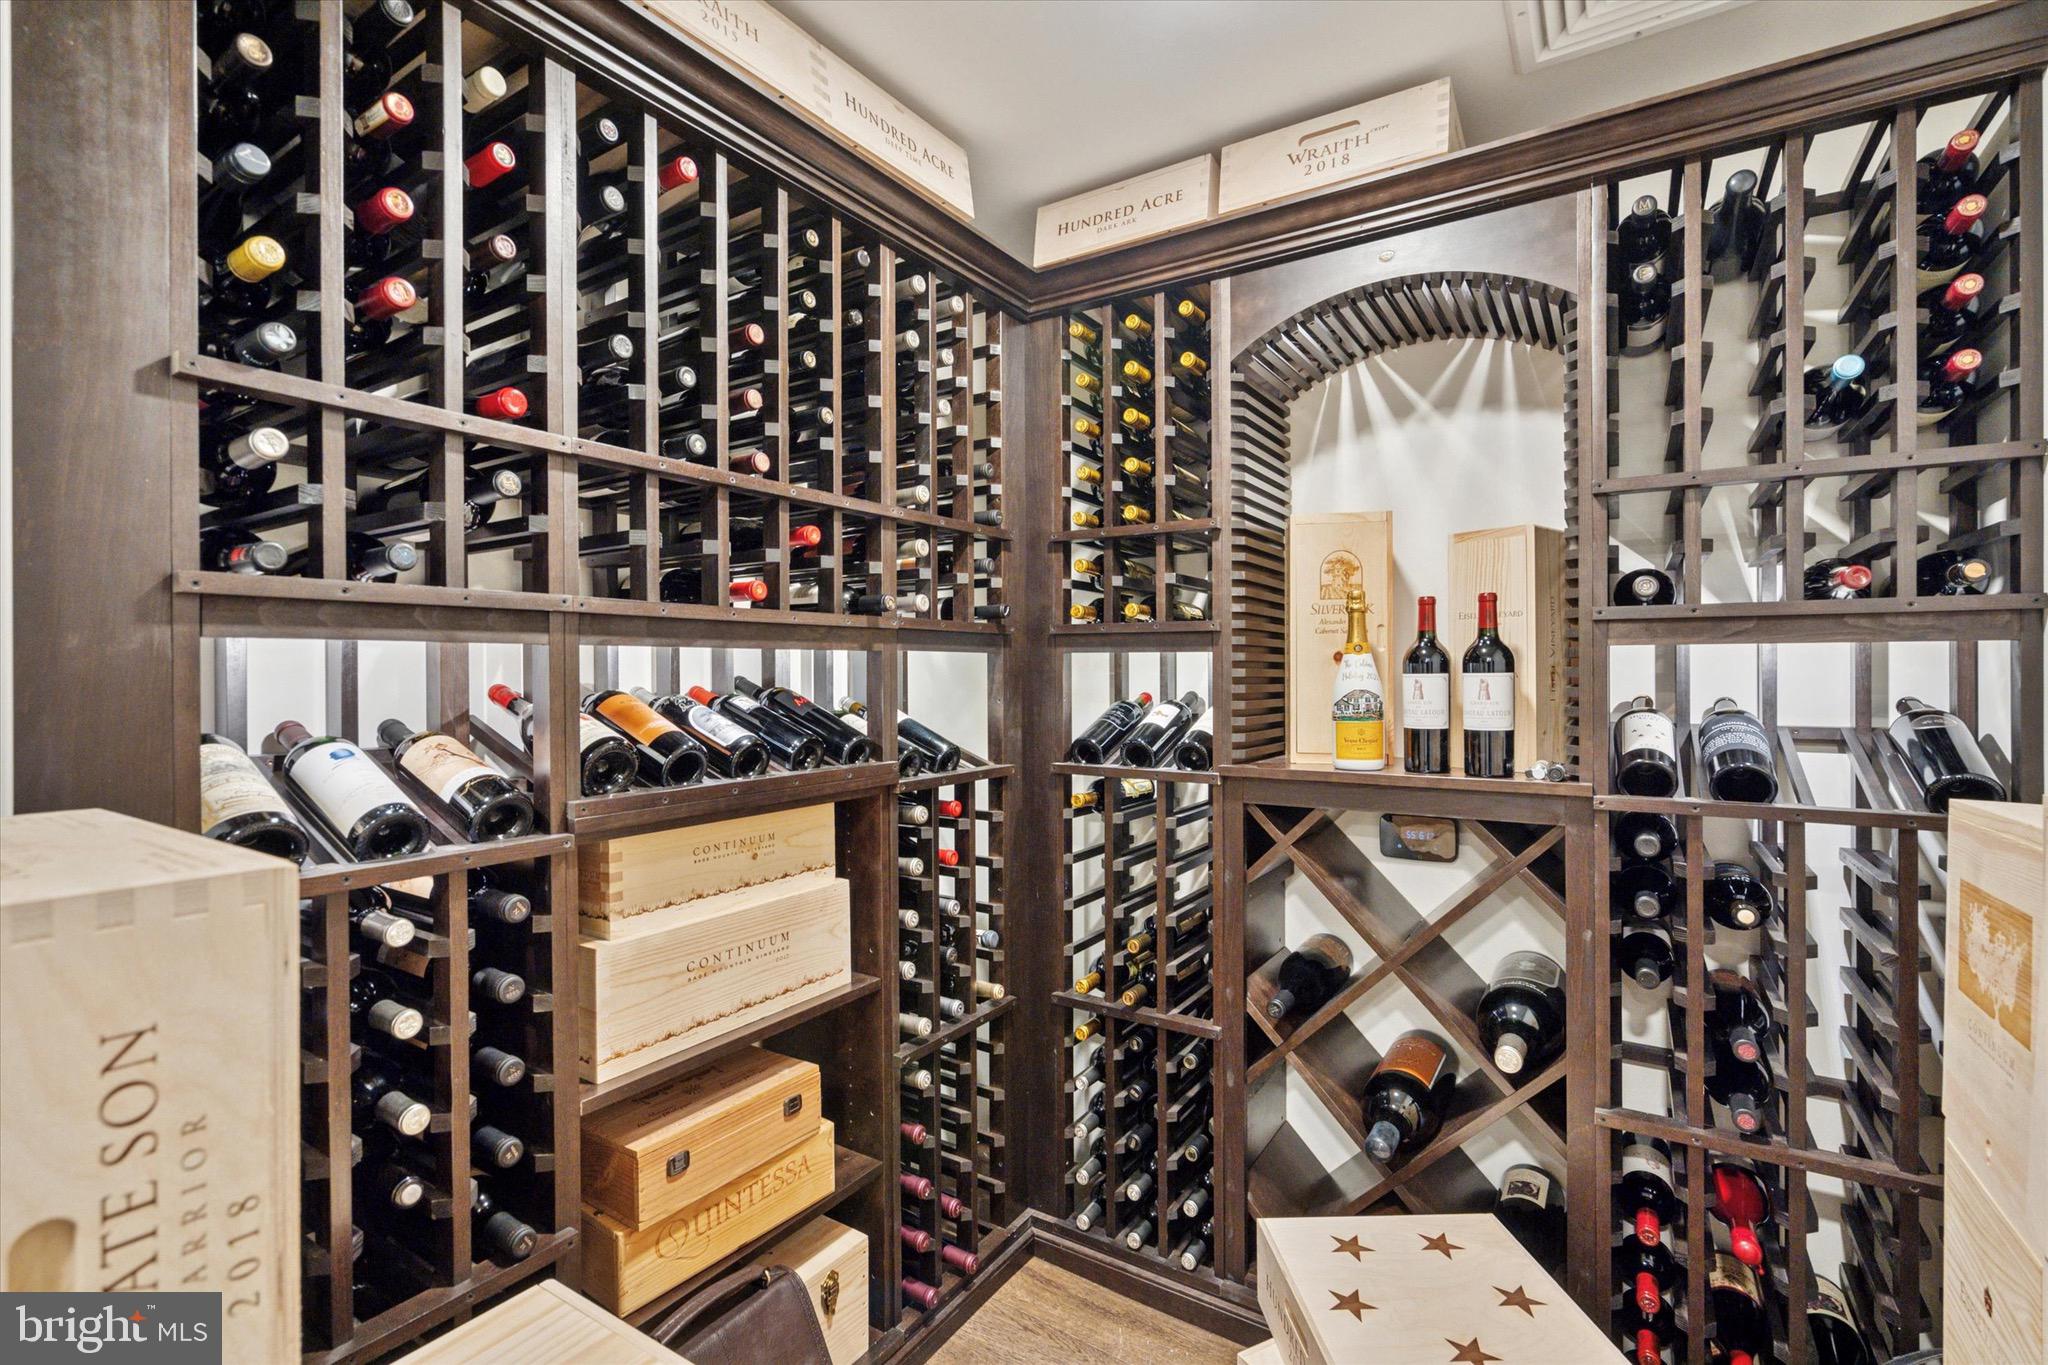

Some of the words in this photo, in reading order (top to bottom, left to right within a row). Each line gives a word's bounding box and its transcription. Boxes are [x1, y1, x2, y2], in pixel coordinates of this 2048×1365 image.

[845, 91, 918, 153] HUNDRED
[922, 146, 954, 179] ACRE
[1288, 132, 1370, 165] WRAITH
[1304, 153, 1350, 176] 2018
[1057, 204, 1134, 236] HUNDRED
[1141, 189, 1184, 212] ACRE
[692, 832, 775, 857] CONTINUUM
[686, 931, 790, 973] CONTINUUM
[97, 1023, 159, 1167] SON
[655, 1153, 812, 1260] QUINTESSA
[227, 1193, 261, 1319] 2018
